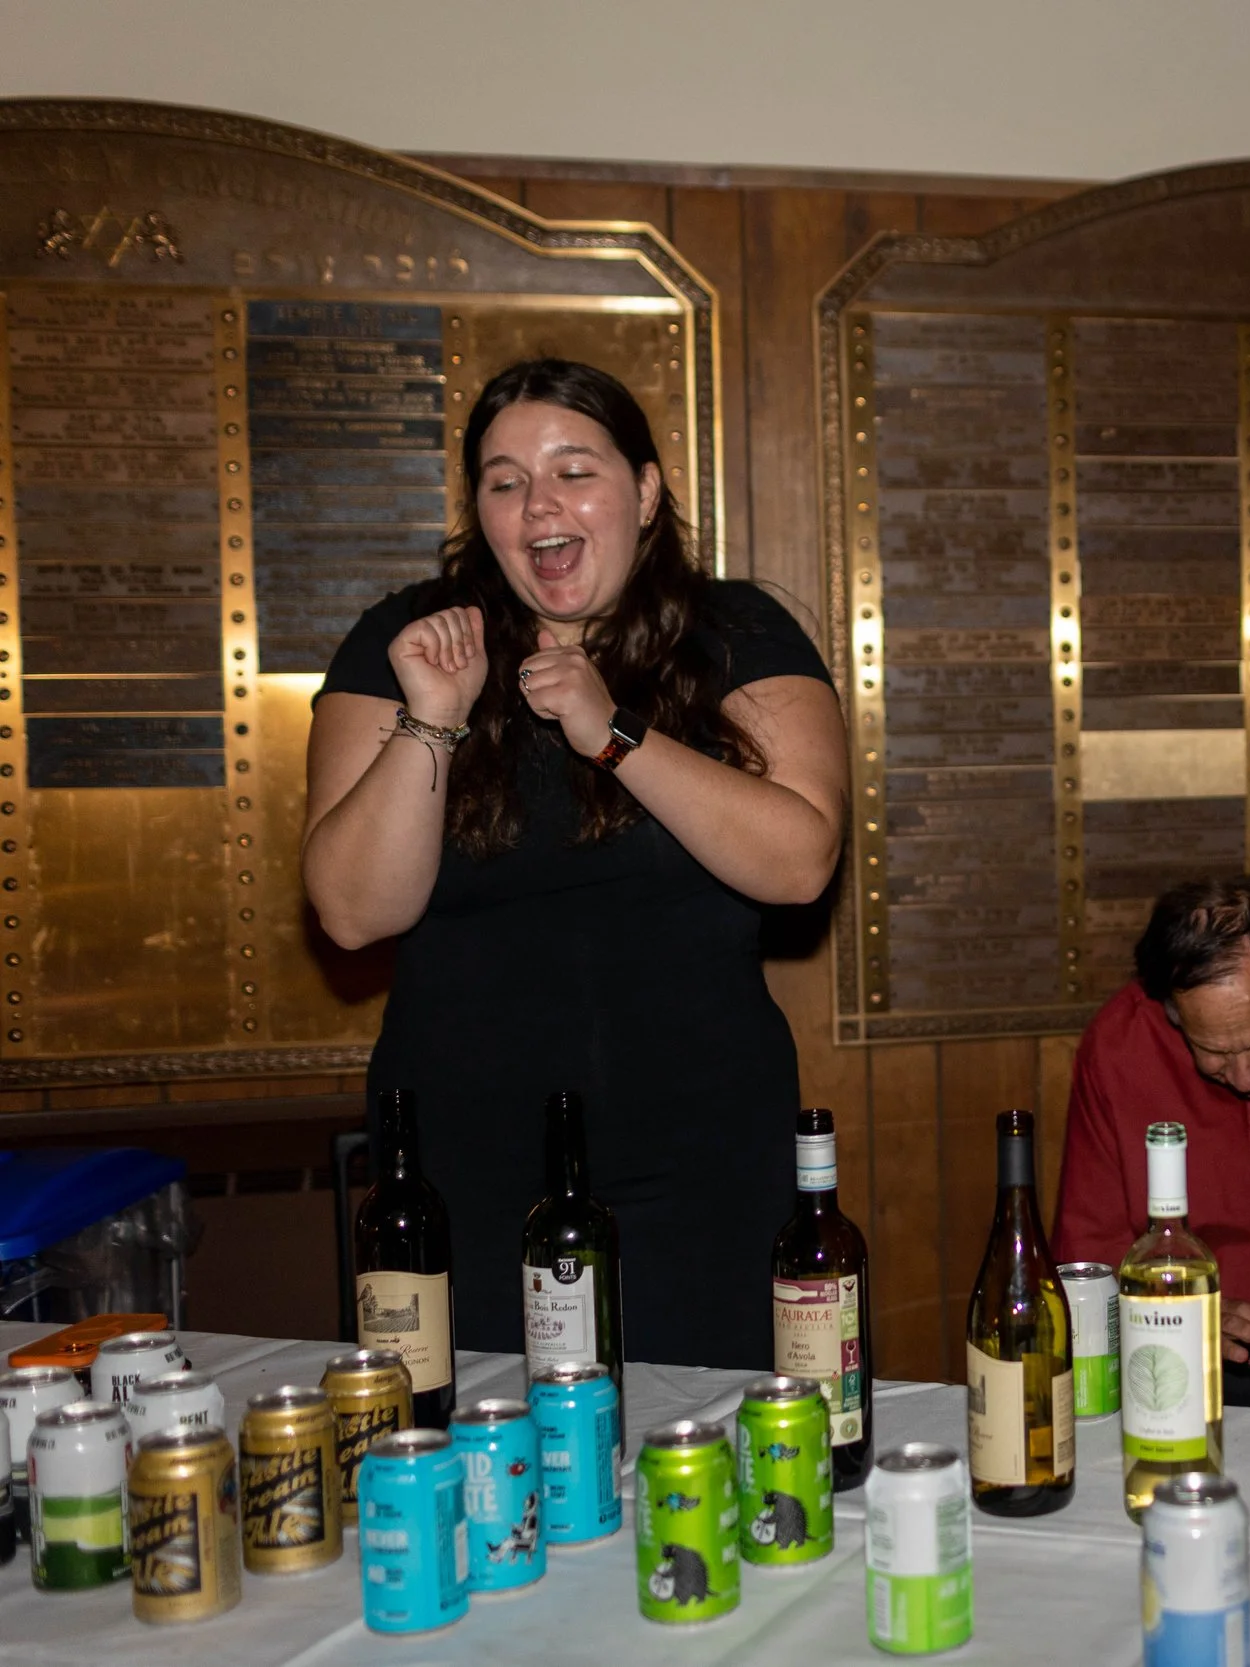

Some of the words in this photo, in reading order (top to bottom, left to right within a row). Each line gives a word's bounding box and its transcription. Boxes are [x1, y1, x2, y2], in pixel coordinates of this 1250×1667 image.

[560, 1262, 575, 1276] 91
[551, 1301, 578, 1312] Redon
[111, 1374, 141, 1387] BLACK
